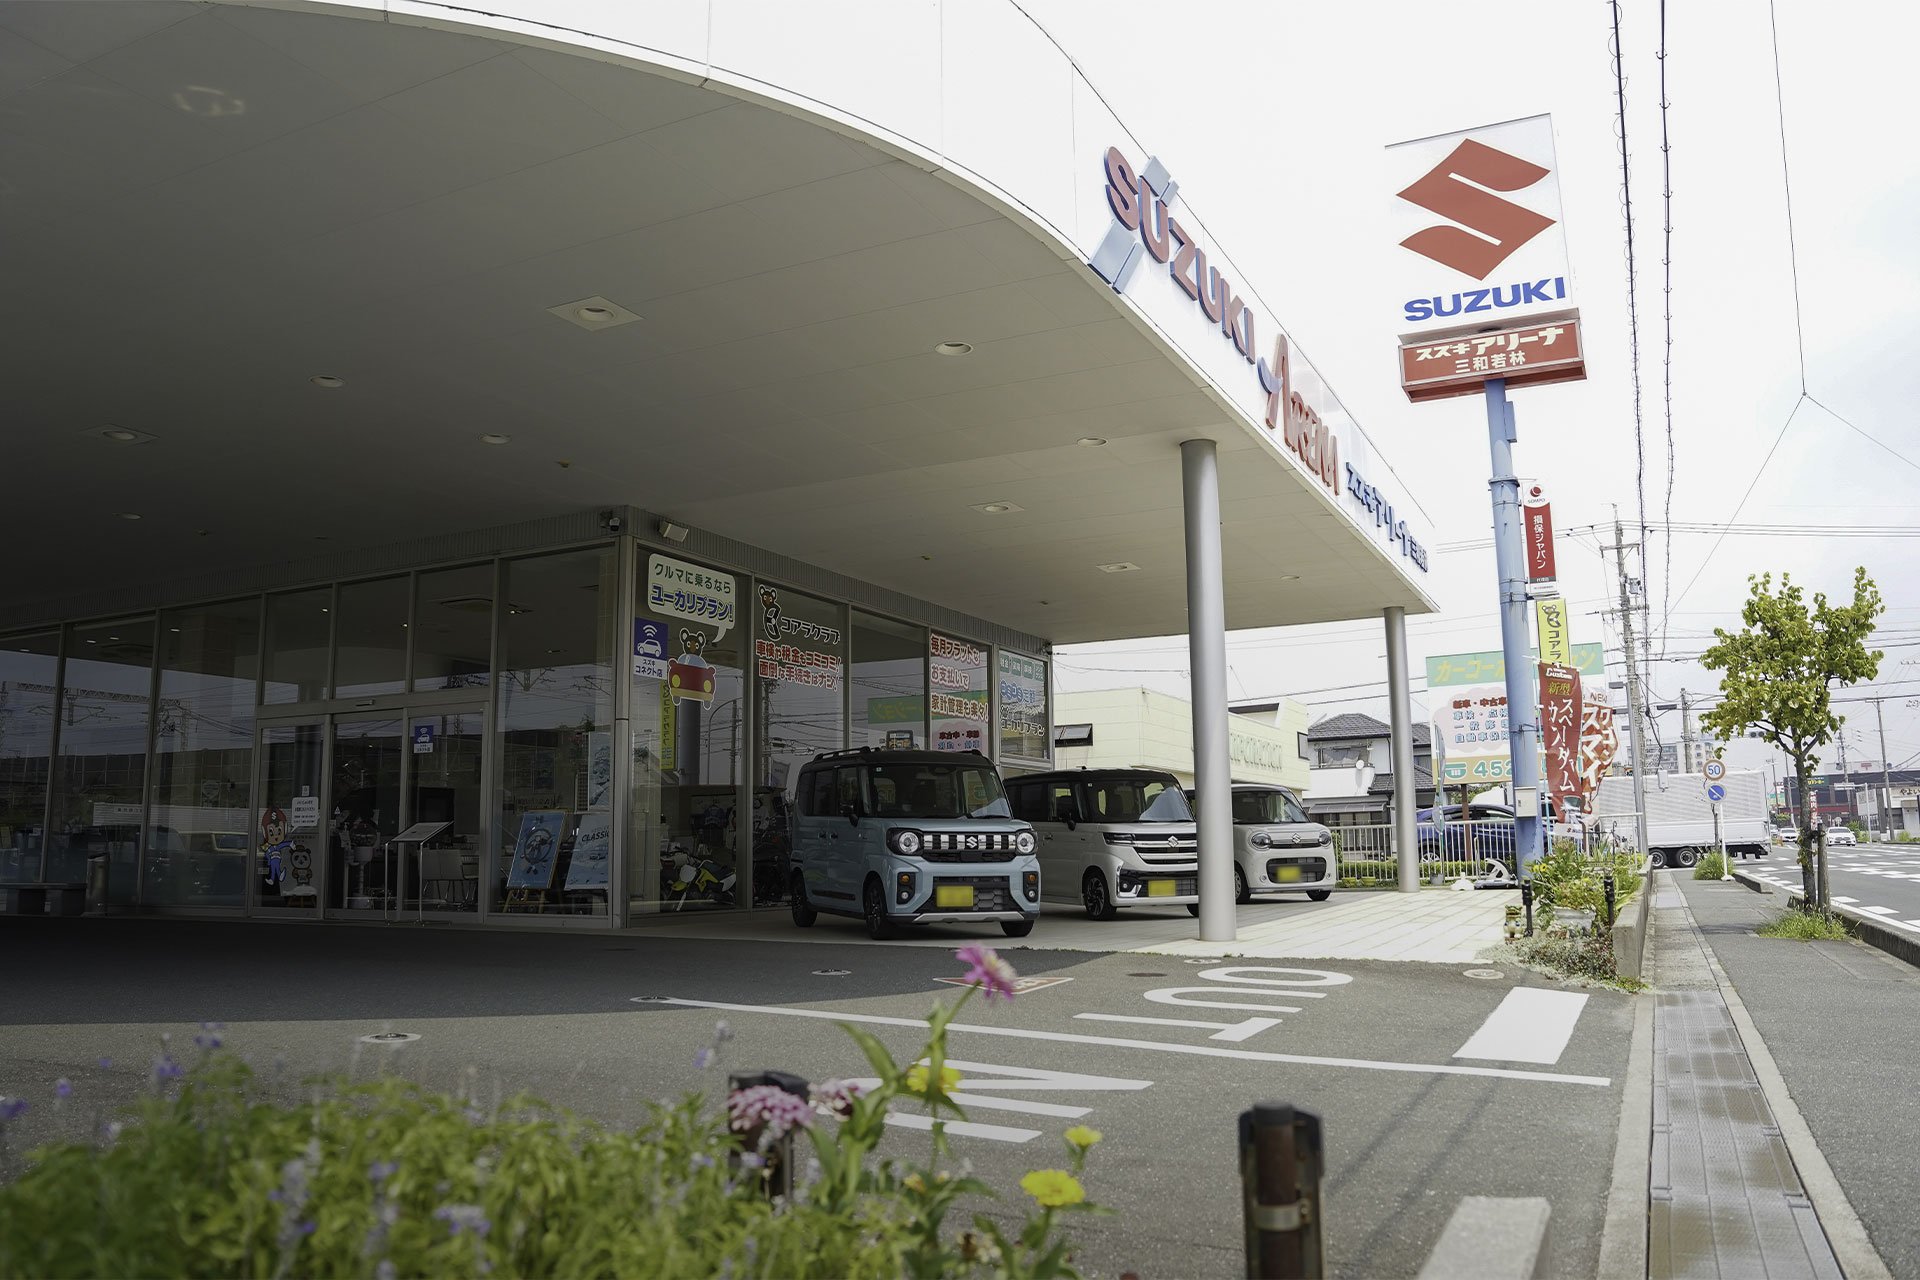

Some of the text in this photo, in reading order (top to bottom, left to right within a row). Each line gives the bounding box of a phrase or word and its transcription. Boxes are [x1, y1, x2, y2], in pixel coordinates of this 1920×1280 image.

[1104, 146, 1255, 364] SUZUKI
[1403, 276, 1566, 322] SUZUKI
[1415, 327, 1565, 361] スズキアリーナ
[1455, 350, 1527, 374] 三和若林
[1533, 514, 1547, 570] 損保ジャパン
[654, 562, 732, 595] クルマに乗るなら
[651, 584, 734, 622] ユーカリプラン!
[930, 633, 980, 666] 毎月フラットな
[635, 664, 663, 678] コネクト店
[930, 663, 970, 691] お支払いで
[1453, 697, 1507, 709] 新車・中古車
[1548, 682, 1571, 696] 新型
[1590, 690, 1608, 704] NEW
[930, 691, 989, 724] 家計管理も楽々!
[1708, 765, 1721, 775] 50
[1072, 966, 1354, 1042] OUT
